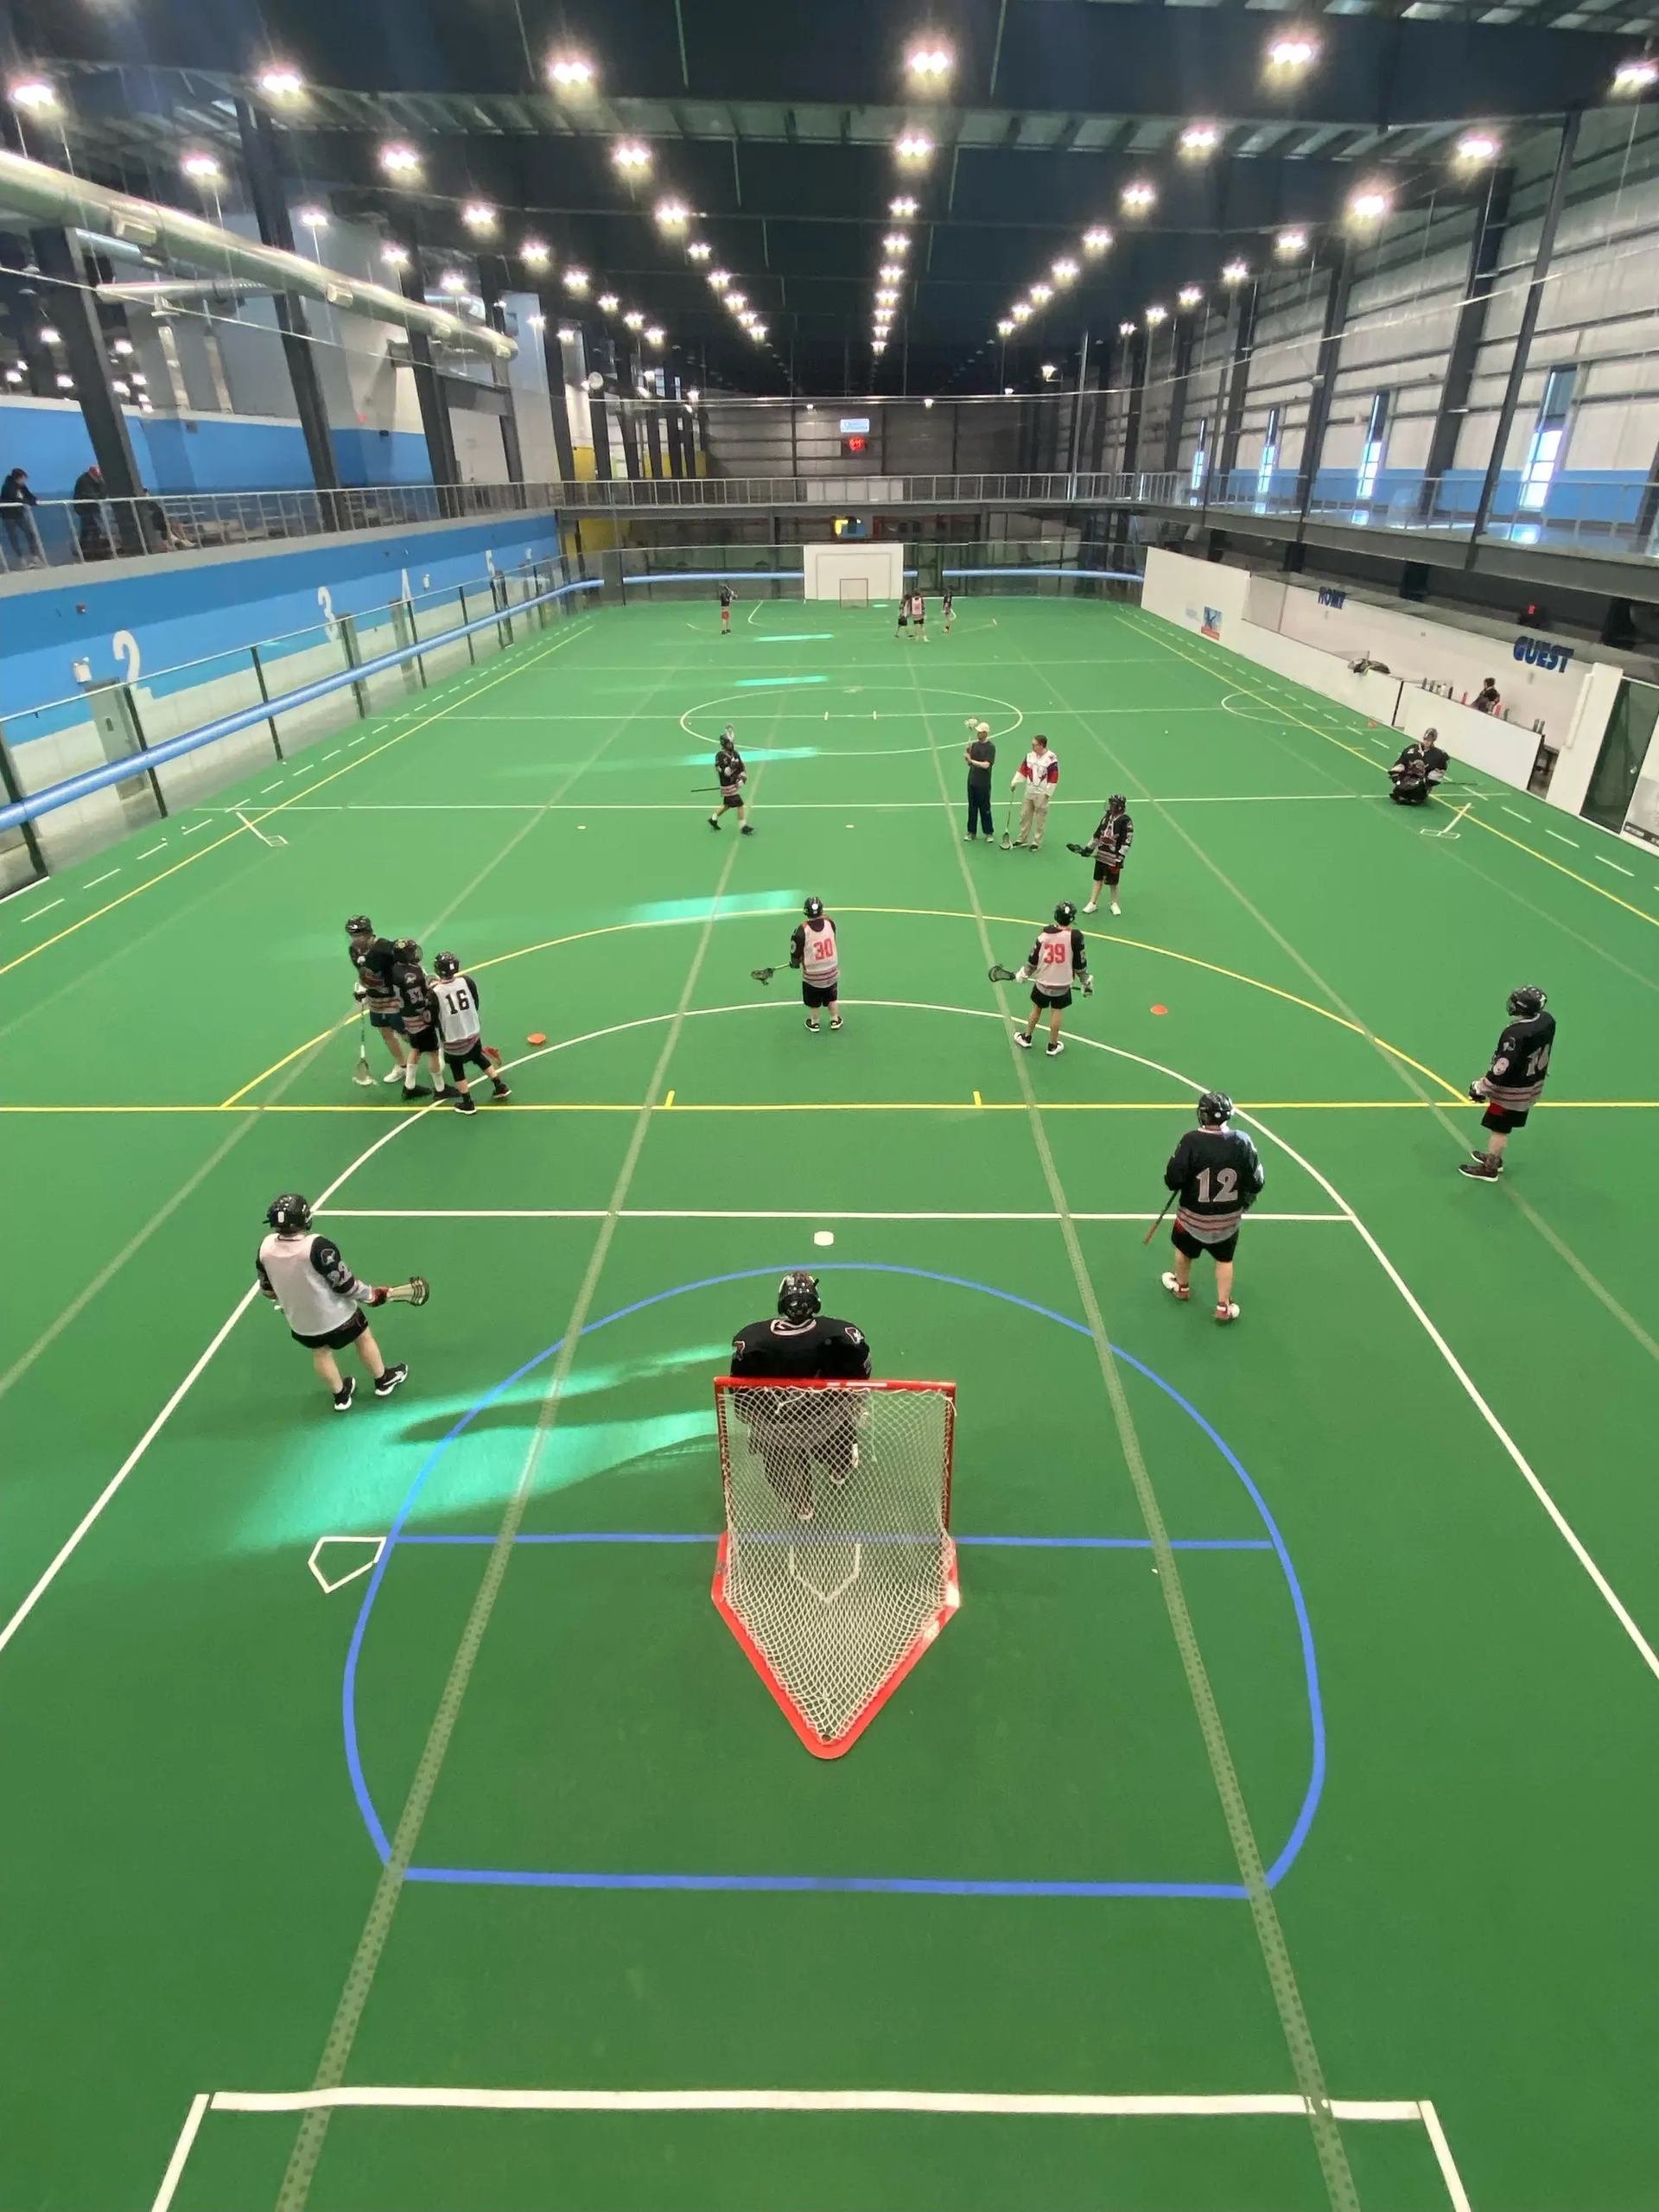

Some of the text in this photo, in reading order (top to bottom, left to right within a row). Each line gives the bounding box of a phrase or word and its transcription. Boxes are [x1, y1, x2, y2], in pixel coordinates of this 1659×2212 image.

[318, 587, 338, 641] 3
[1513, 635, 1574, 673] GUEST
[814, 938, 833, 960] 30
[1044, 944, 1065, 963] 39
[445, 989, 469, 1014] 16
[1196, 1167, 1238, 1203] 12
